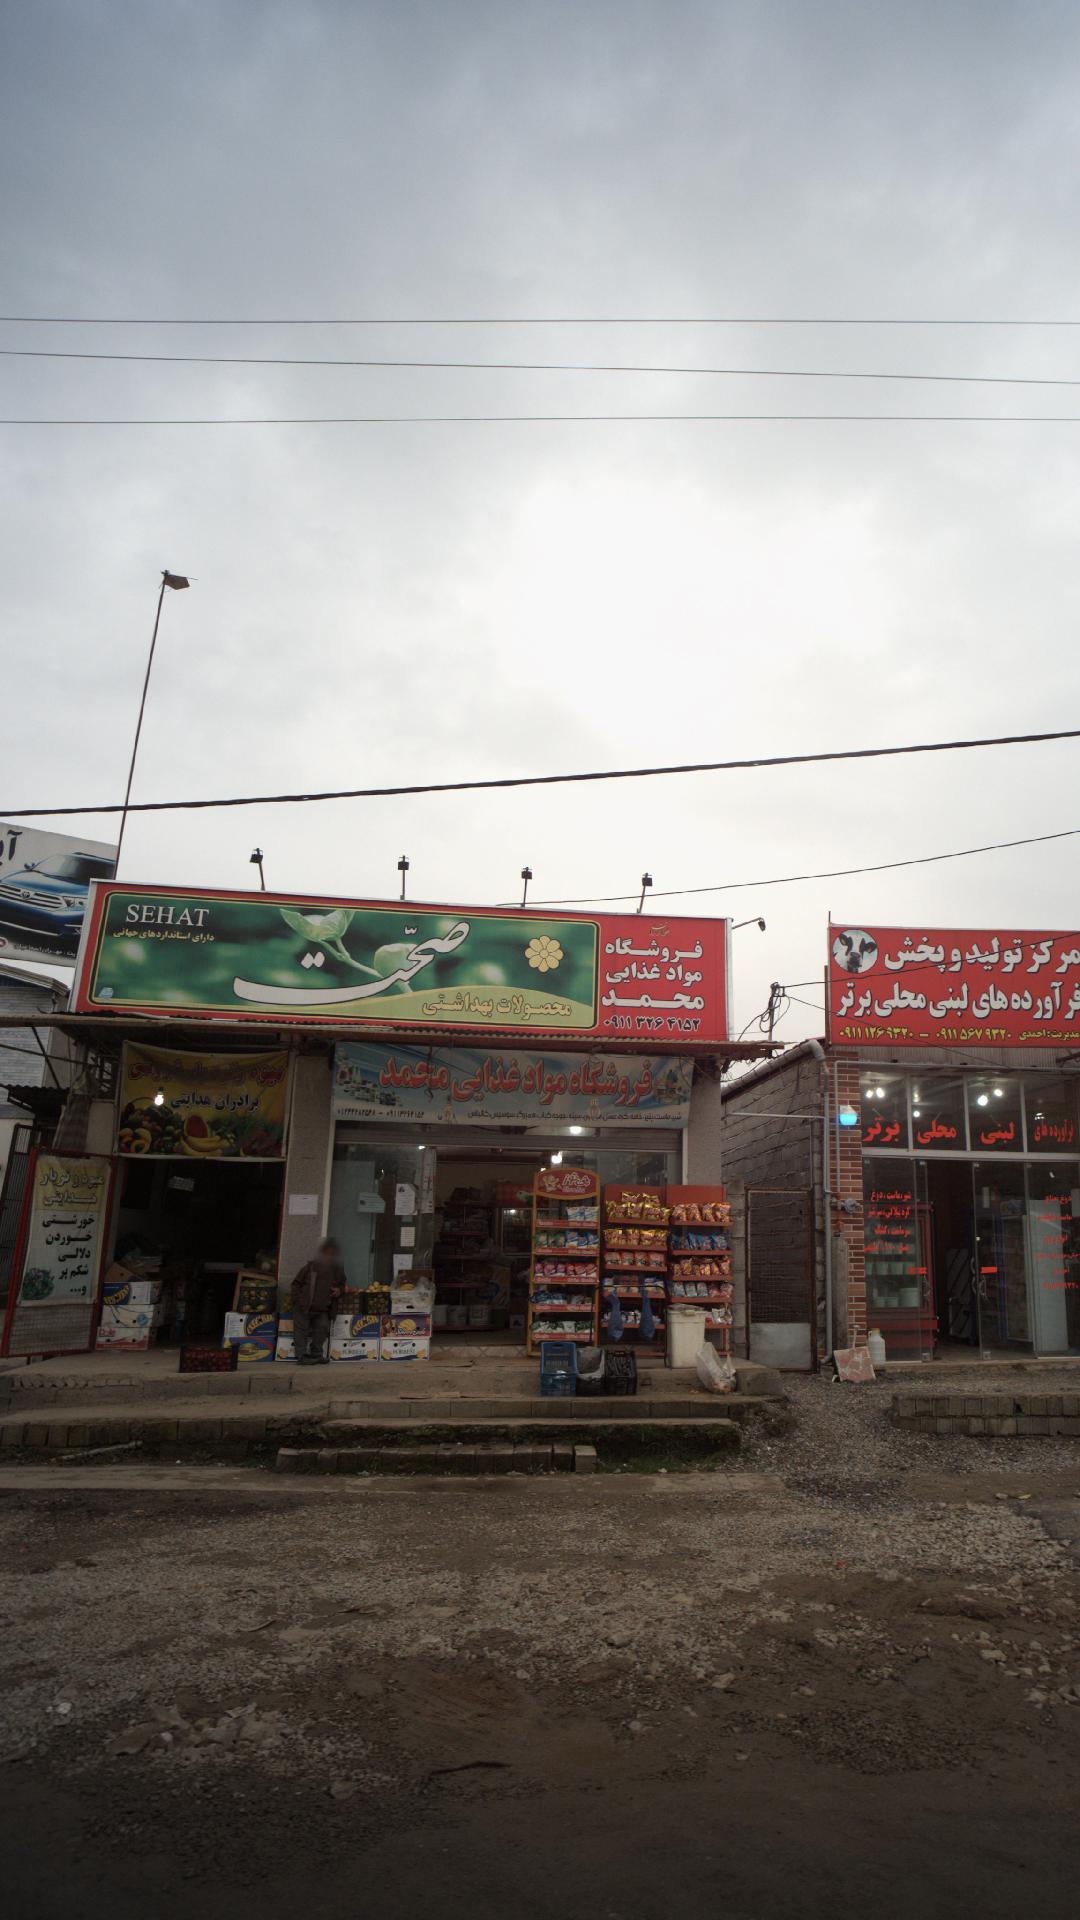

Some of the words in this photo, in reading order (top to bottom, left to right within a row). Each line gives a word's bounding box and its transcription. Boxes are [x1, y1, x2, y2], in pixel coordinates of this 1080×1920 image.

[126, 904, 210, 928] SEHAT
[113, 928, 138, 938] جهانی
[191, 933, 215, 943] دارای
[605, 938, 703, 963] فروشگاه
[884, 936, 945, 974] پخش
[948, 947, 962, 973] و
[965, 937, 1023, 973] تولید
[605, 961, 662, 984] غذایی
[665, 964, 703, 987] مواد
[422, 991, 494, 1018] بهداشتی
[496, 994, 573, 1021] محصولات
[601, 988, 705, 1011] محمد
[836, 982, 873, 1017] برتر
[874, 981, 927, 1018] محلی
[929, 982, 969, 1018] لبنی
[603, 1015, 632, 1029] ۰۹۱۱
[636, 1015, 665, 1031] ۳۲۶
[667, 1016, 701, 1032] ۴۱۵۲
[378, 1056, 450, 1089] محمد
[451, 1056, 521, 1102] غذایی
[521, 1059, 567, 1105] مواد
[569, 1059, 653, 1107] فروشگاه
[862, 1116, 900, 1142] برتر
[917, 1119, 957, 1144] محلی
[979, 1121, 1015, 1146] لبنی
